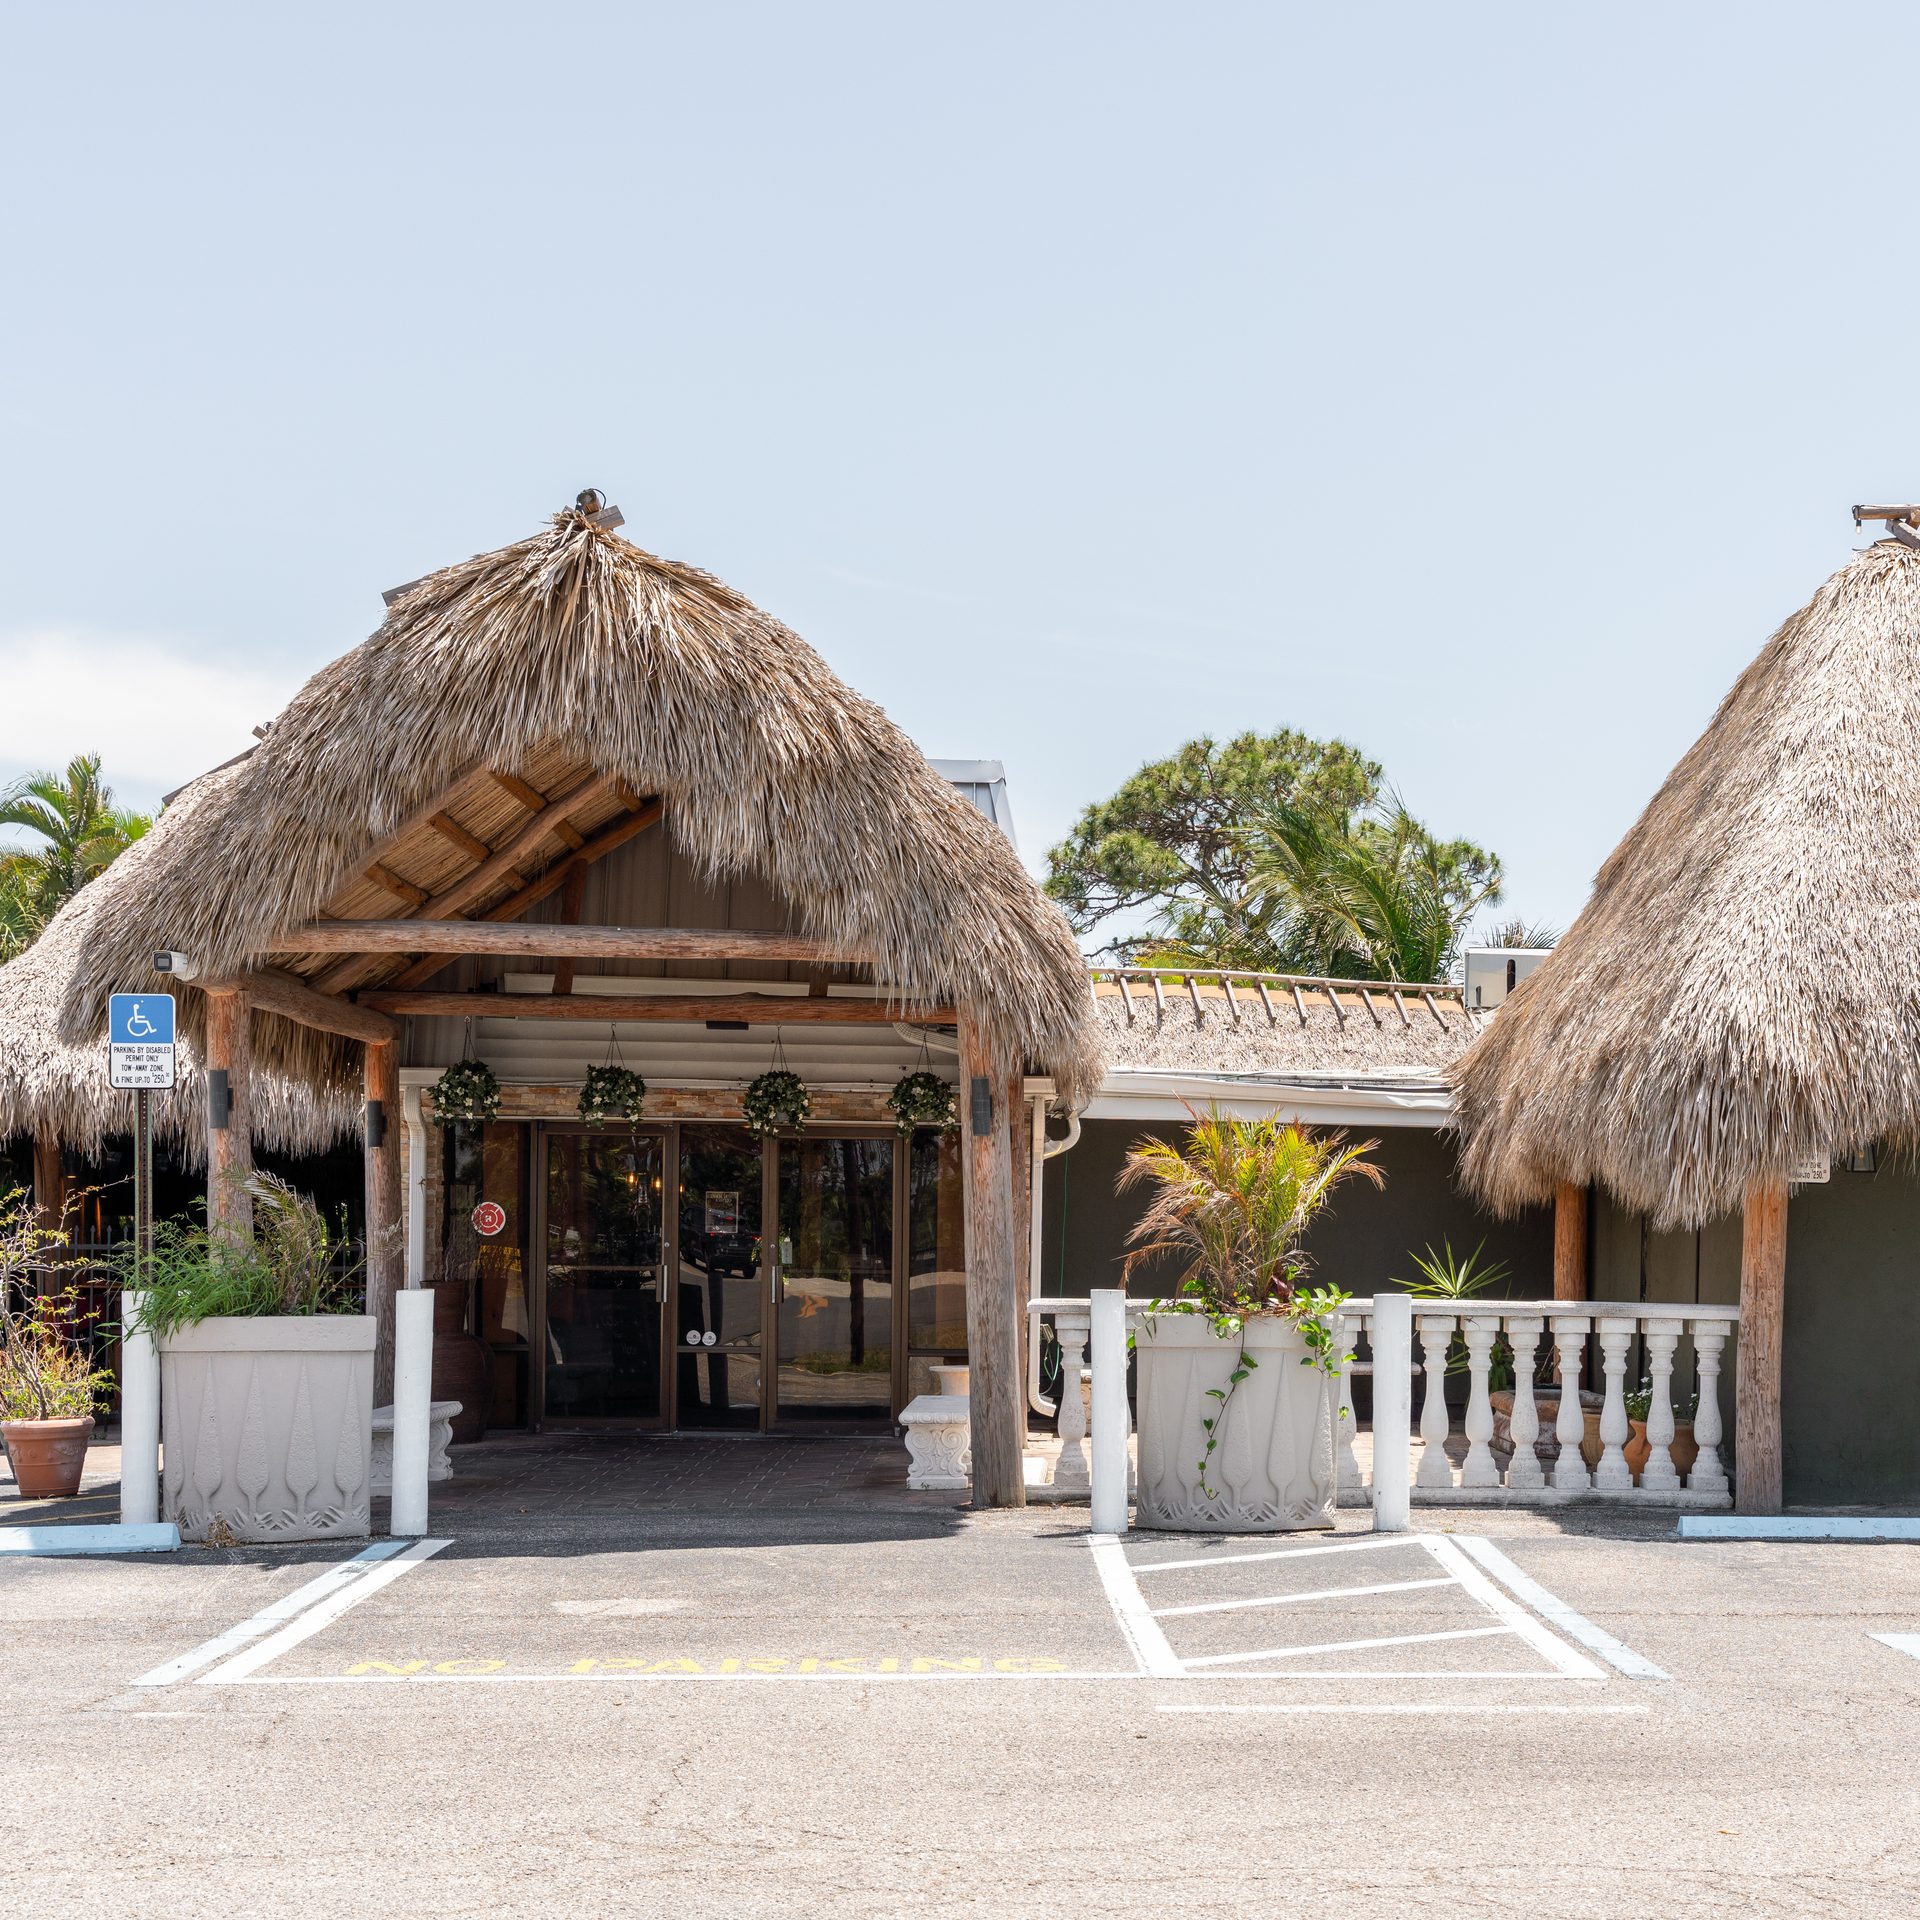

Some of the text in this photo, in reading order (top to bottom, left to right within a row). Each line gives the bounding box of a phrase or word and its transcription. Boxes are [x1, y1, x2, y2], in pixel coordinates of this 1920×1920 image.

[113, 1046, 171, 1054] PARKING BY DISABLED
[344, 1657, 1068, 1675] NO PARKING
